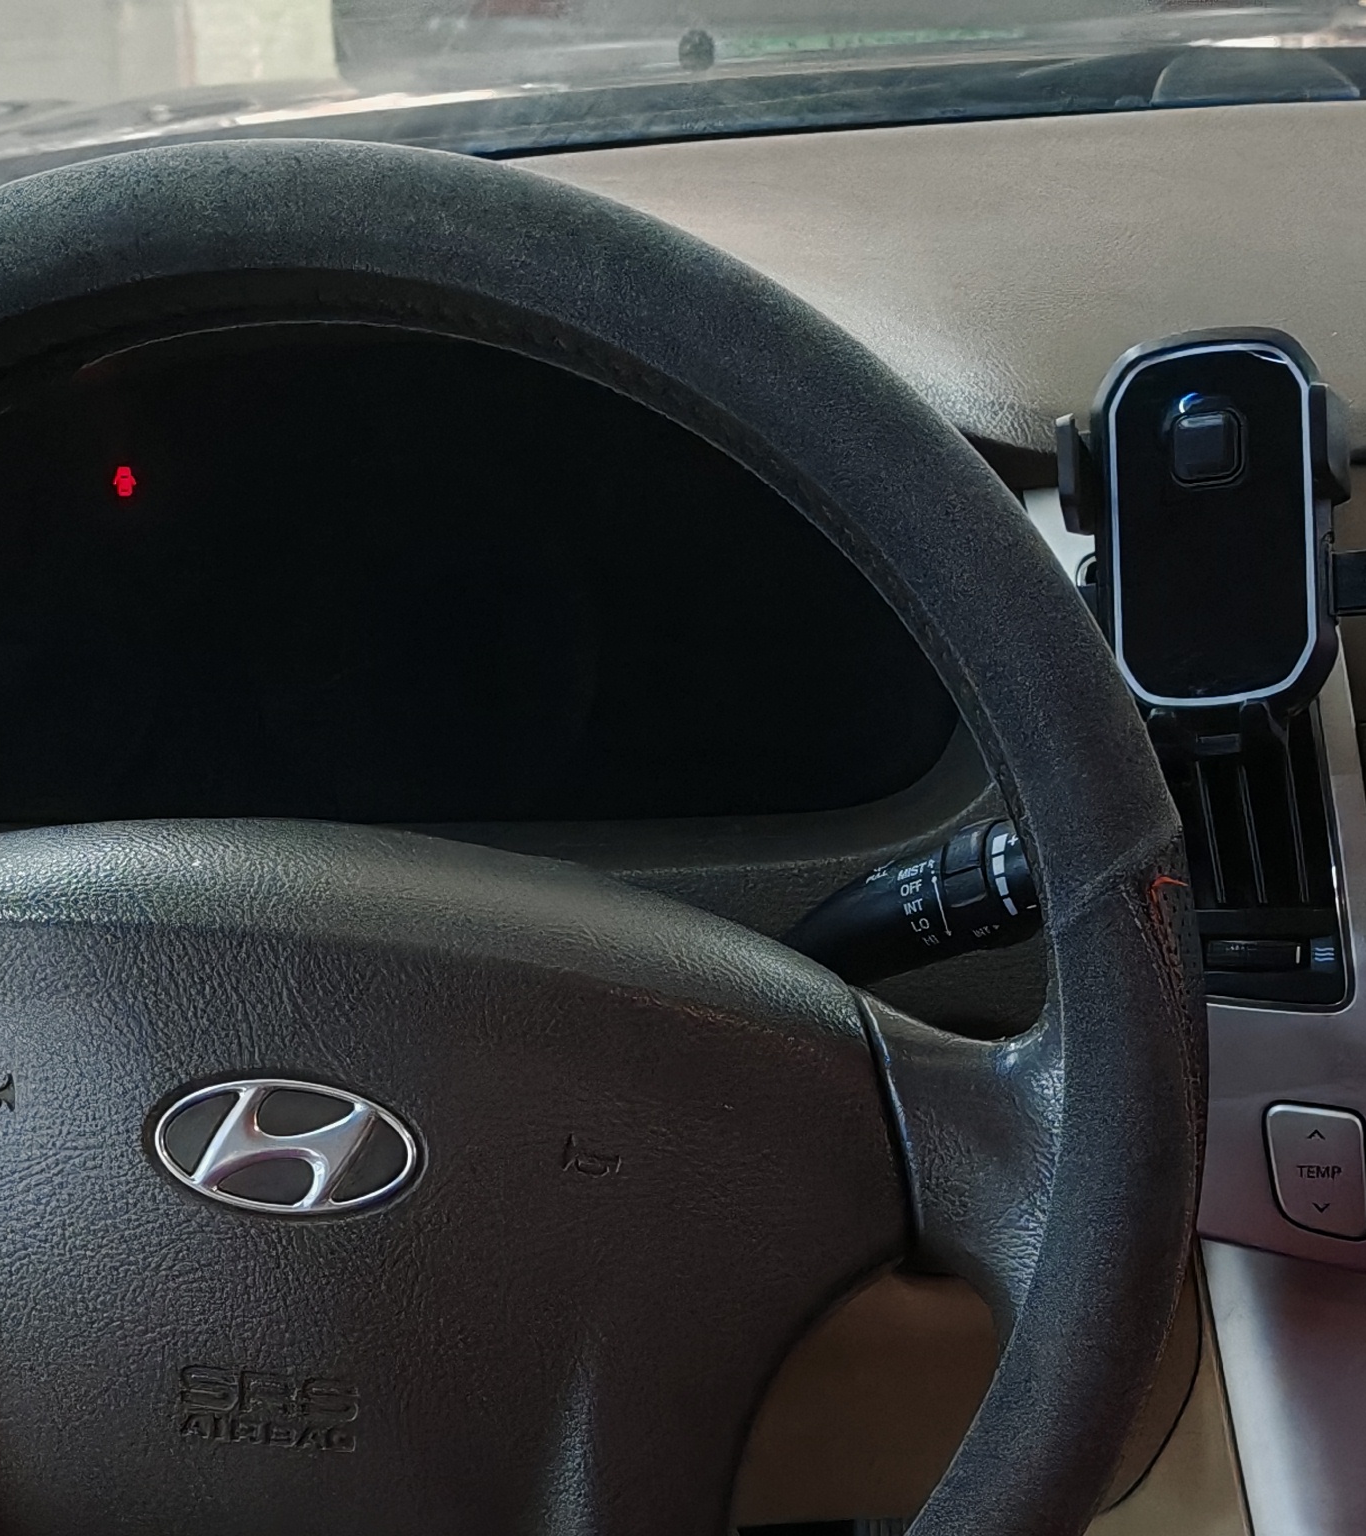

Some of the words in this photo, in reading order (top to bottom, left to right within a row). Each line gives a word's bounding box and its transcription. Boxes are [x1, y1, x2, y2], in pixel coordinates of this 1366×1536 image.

[897, 863, 927, 881] MIST
[900, 880, 923, 897] OFF
[903, 899, 923, 916] INT
[910, 917, 931, 933] LO
[1296, 1164, 1343, 1180] TEMP
[181, 1364, 360, 1422] SRS
